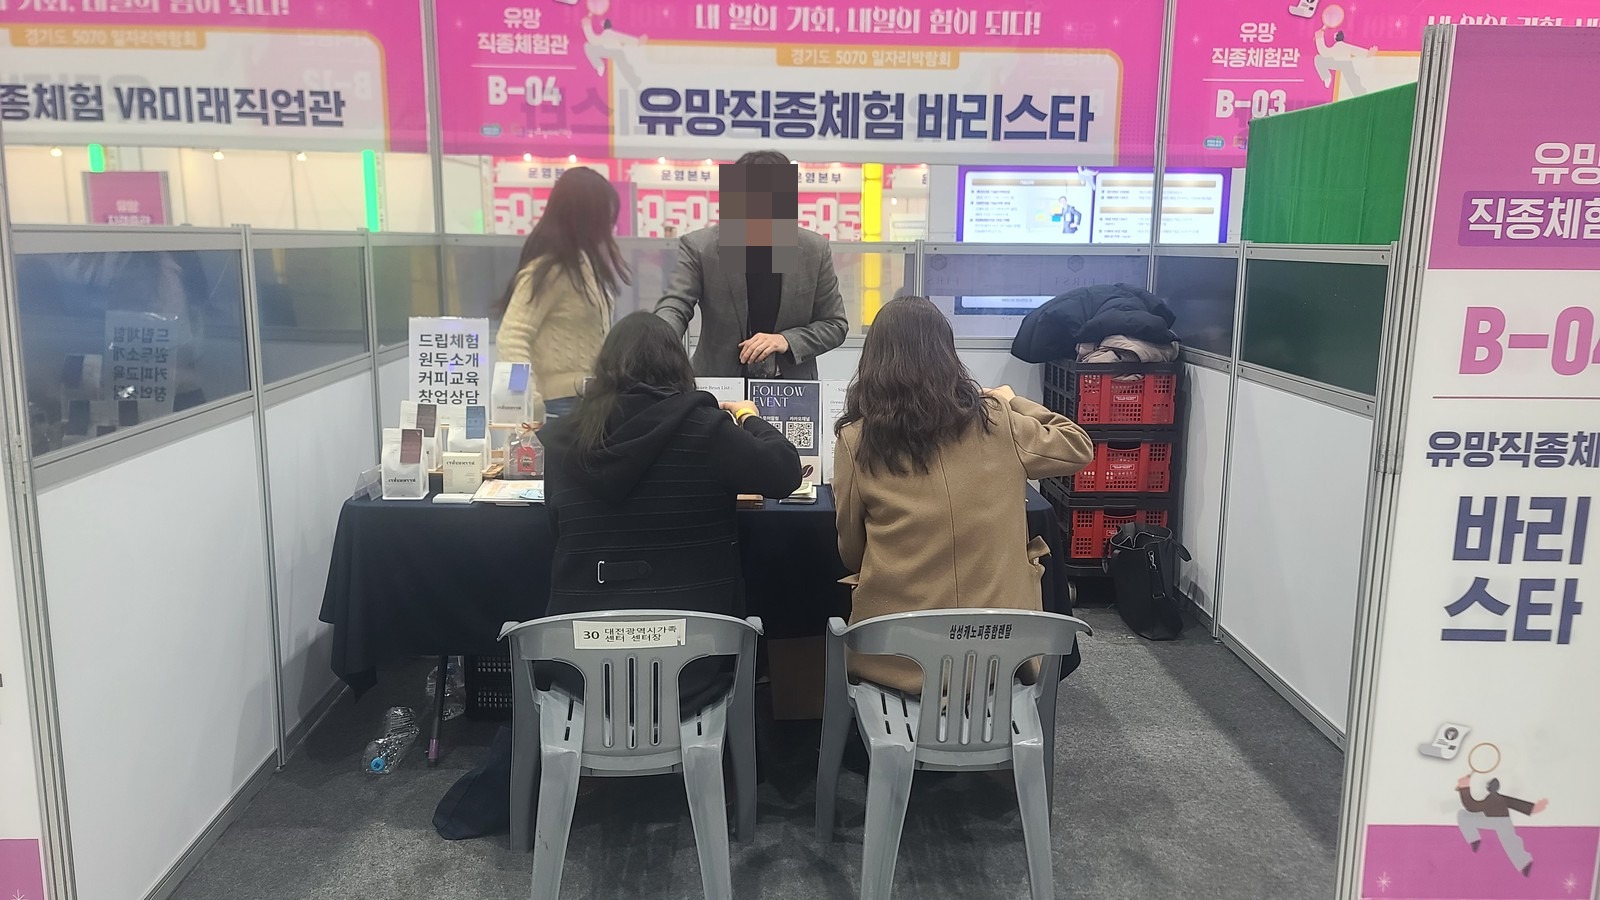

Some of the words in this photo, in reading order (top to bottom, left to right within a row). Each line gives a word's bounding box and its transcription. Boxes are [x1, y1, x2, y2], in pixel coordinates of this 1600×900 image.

[503, 8, 541, 29] 유망
[695, 4, 720, 30] 내
[728, 3, 777, 31] 일의
[786, 6, 841, 34] 기회,
[848, 6, 920, 34] 내일의
[929, 8, 977, 36] 힘이
[984, 10, 1041, 36] 되다!
[72, 30, 106, 46] 5070
[1239, 22, 1277, 43] 유망
[477, 33, 569, 55] 직종체험관
[791, 49, 831, 65] 경기도
[836, 51, 867, 66] 5070
[872, 50, 951, 68] 일자리박람회
[1211, 47, 1300, 68] 직종체험관
[488, 75, 561, 106] B-04
[114, 86, 346, 128] VR미래직업관
[1215, 89, 1287, 118] B-03
[638, 87, 905, 140] 유망직종체험
[917, 93, 1094, 142] 바리스타
[661, 169, 711, 181] 운영본부
[418, 333, 480, 349] 드립체험
[1458, 306, 1600, 376] B-0
[418, 352, 480, 368] 원두소개
[418, 371, 480, 387] 커피교육
[418, 390, 480, 405] 창업상담
[753, 385, 806, 396] FOLLOW
[753, 396, 789, 407] EVENT
[1452, 496, 1592, 565] 바리
[1440, 576, 1583, 645] 스타
[583, 630, 600, 640] 30
[604, 625, 677, 636] 대전광역시가족
[605, 633, 625, 643] 센터
[631, 633, 662, 643] 센터장
